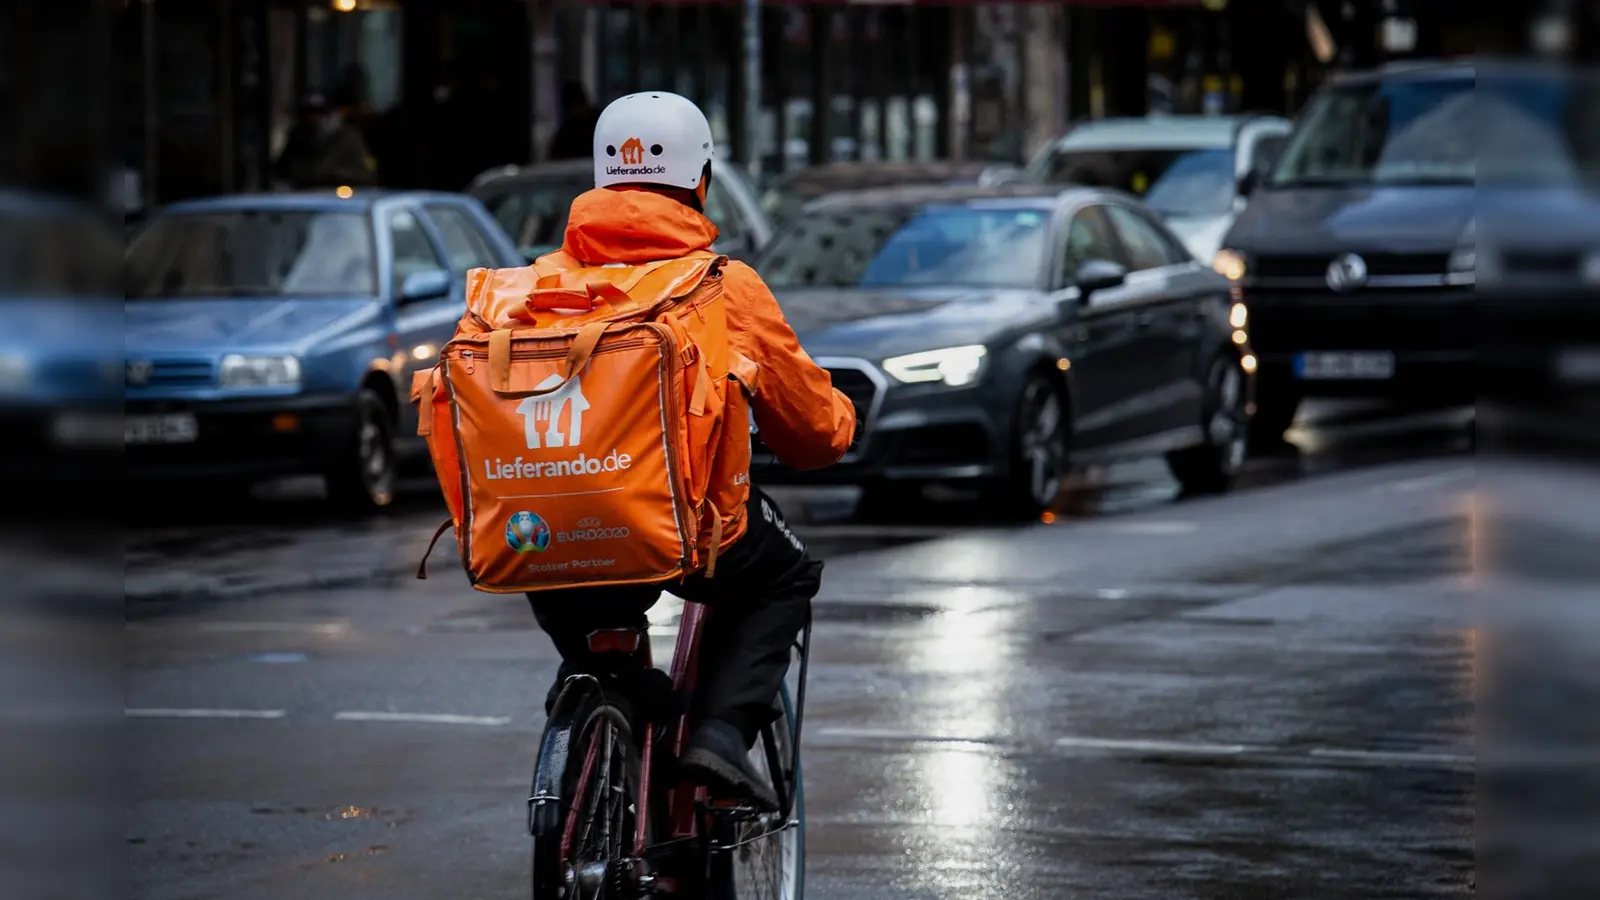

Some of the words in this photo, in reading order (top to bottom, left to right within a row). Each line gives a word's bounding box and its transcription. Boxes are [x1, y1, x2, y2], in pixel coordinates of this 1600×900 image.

[606, 165, 666, 175] Lieferando.de
[484, 448, 632, 480] Lieferando.de
[556, 526, 630, 543] EURO2020
[527, 562, 569, 573] Stolzer
